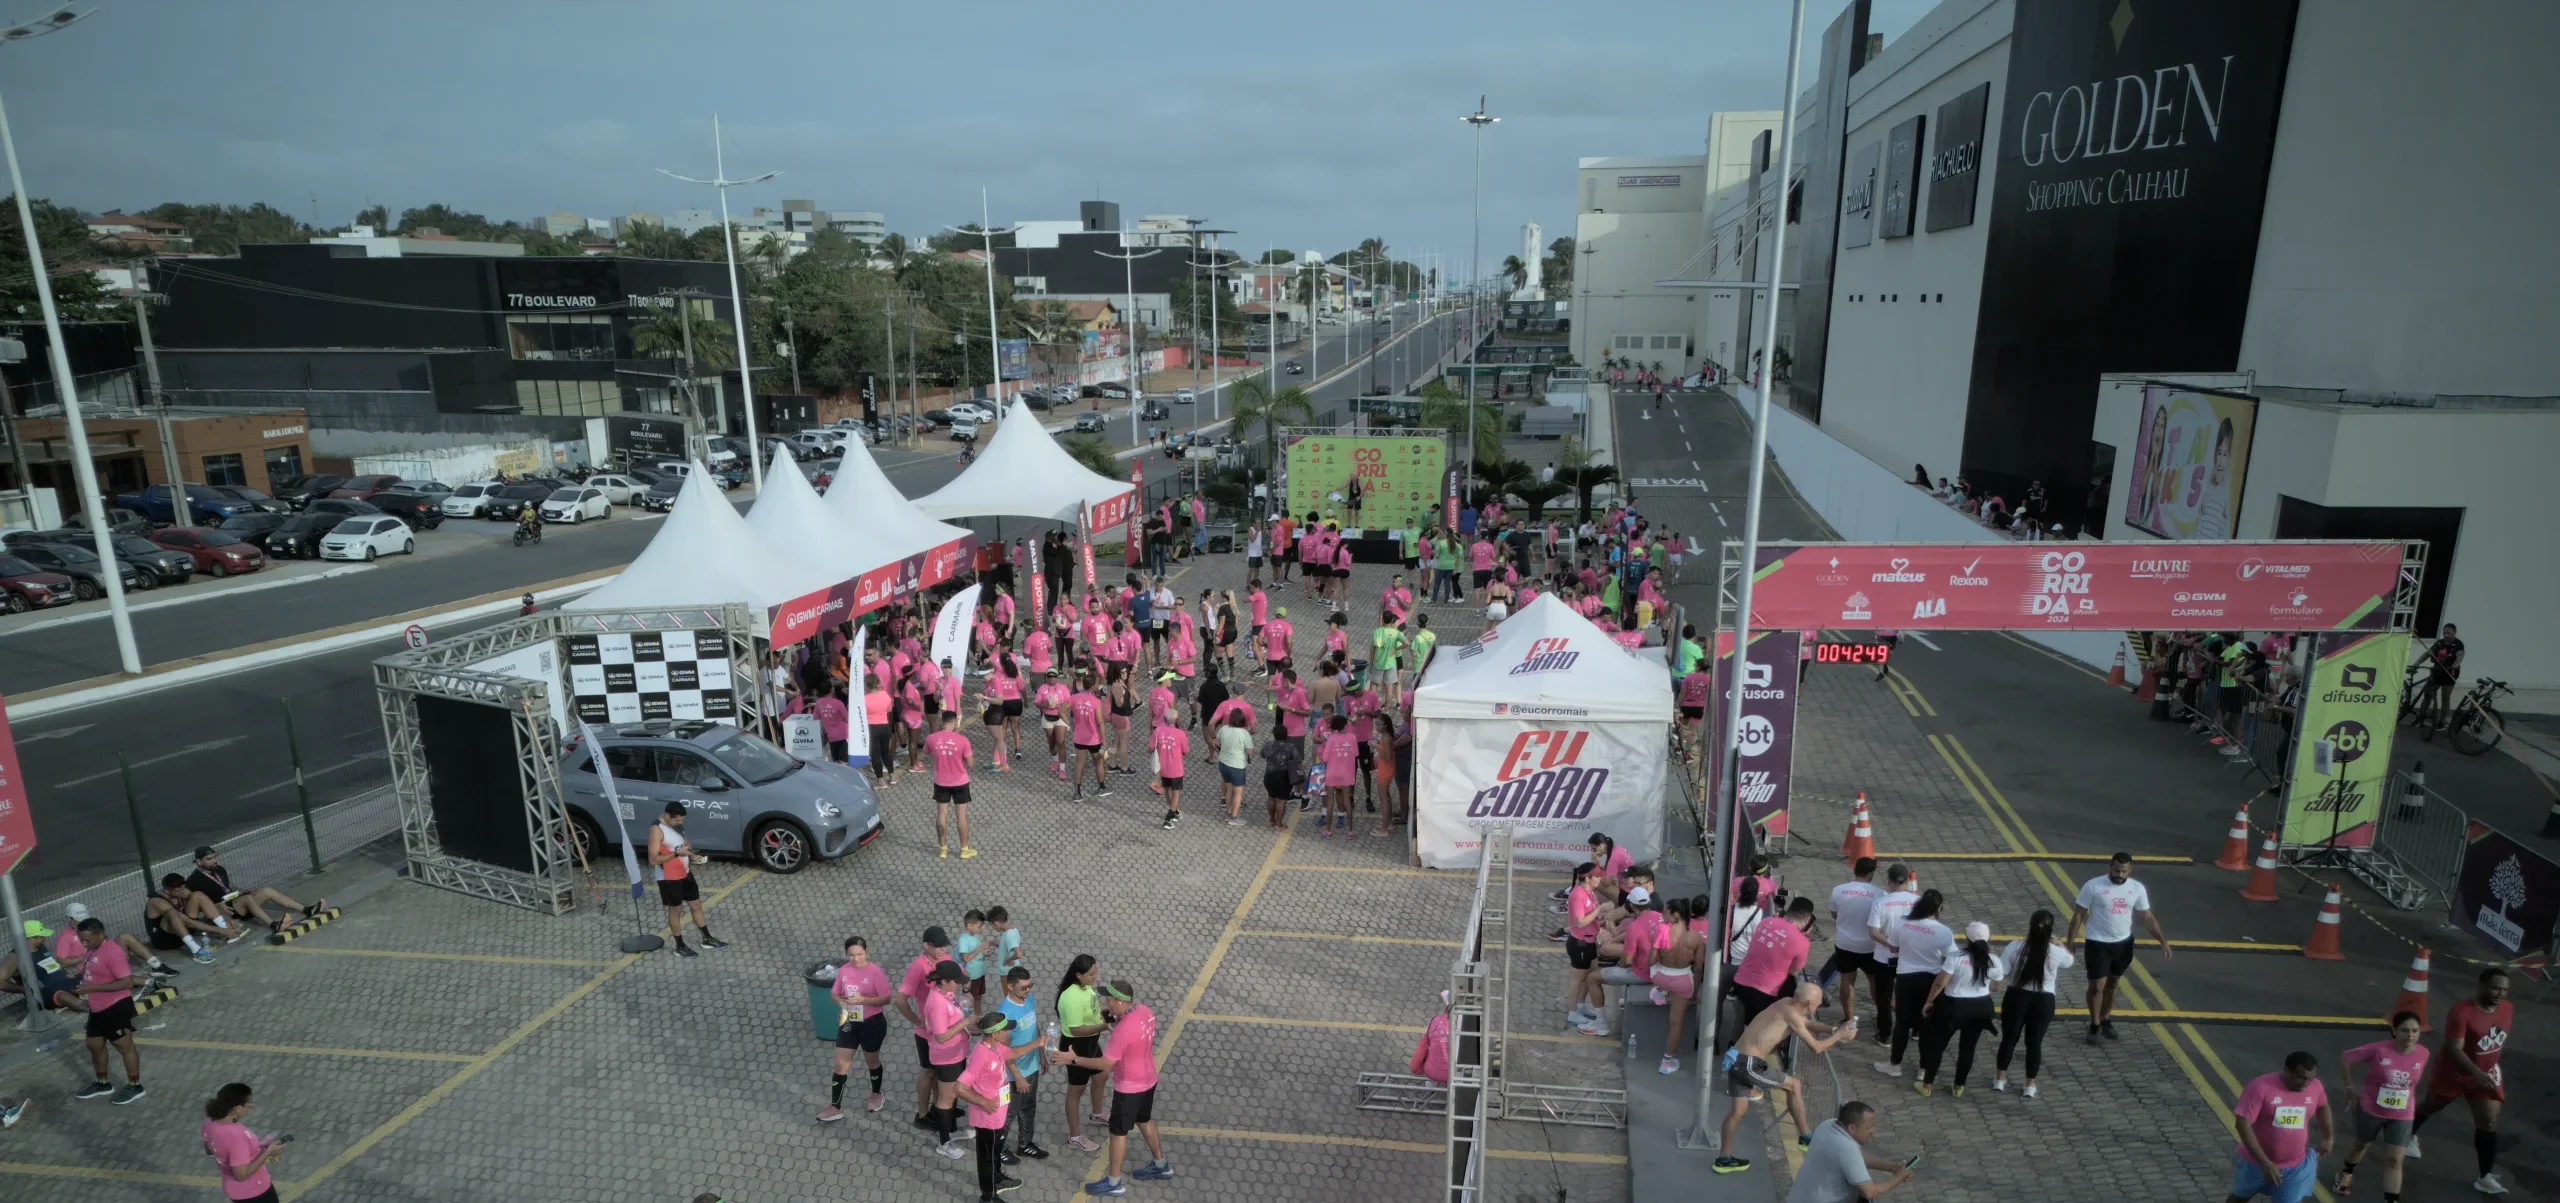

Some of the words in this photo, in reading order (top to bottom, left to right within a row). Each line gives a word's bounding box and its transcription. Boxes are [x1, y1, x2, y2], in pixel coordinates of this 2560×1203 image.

[2021, 55, 2235, 167] GOLDEN
[1930, 141, 1976, 183] RIACHUELO
[1618, 177, 1637, 185] LOJAS
[1639, 176, 1680, 185] AMERICANAS
[2026, 177, 2104, 212] SHOPPING
[2107, 168, 2189, 204] CALHAU
[507, 293, 523, 307] 77
[525, 295, 596, 307] BOULEVARD
[628, 294, 637, 307] 77
[862, 388, 869, 399] 77
[868, 375, 876, 411] BOULEVARD
[641, 423, 650, 431] 77
[630, 431, 662, 439] BOULEVARD
[1353, 447, 1382, 463] CO
[1356, 463, 1388, 478] RRI
[1630, 477, 1699, 485] PARE
[2041, 551, 2085, 573] CO
[2131, 559, 2190, 574] LOUVRE
[2264, 564, 2310, 574] VITALMED
[1871, 571, 1926, 585] mateus
[1950, 575, 1988, 587] Rexona
[2042, 573, 2093, 594] RRI
[2153, 571, 2188, 585] magazine
[881, 577, 892, 600] ALA
[1034, 577, 1044, 626] difusora
[2192, 593, 2227, 601] GWM
[797, 608, 815, 624] GWM
[816, 597, 844, 616] CARMAIS
[1912, 598, 1946, 621] ALA
[2031, 594, 2070, 615] DA
[2269, 604, 2322, 616] formulare
[2046, 615, 2069, 623] 2024
[2171, 608, 2224, 617] CARMAIS
[948, 601, 963, 642] CARMAIS
[1525, 637, 1570, 662] EU
[1816, 643, 1888, 662] 004249
[1509, 651, 1580, 676] CORRO
[2322, 690, 2387, 704] difusora
[1510, 704, 1588, 717] @eucorromais
[1738, 721, 1771, 744] sbt
[2326, 726, 2368, 752] sbt
[1496, 730, 1590, 782] EU
[1466, 767, 1609, 820] CORRO
[709, 811, 729, 820] Drive
[1545, 821, 1591, 831] ESPORTIVA
[1841, 889, 1874, 899] PRODUÇÃO
[1903, 923, 1935, 936] PRODUÇÃO
[2480, 912, 2498, 931] mãe
[2498, 920, 2520, 946] terra
[2490, 1026, 2497, 1038] K
[2393, 1070, 2410, 1079] CO
[2383, 1097, 2401, 1106] 401
[2280, 1116, 2298, 1125] 367
